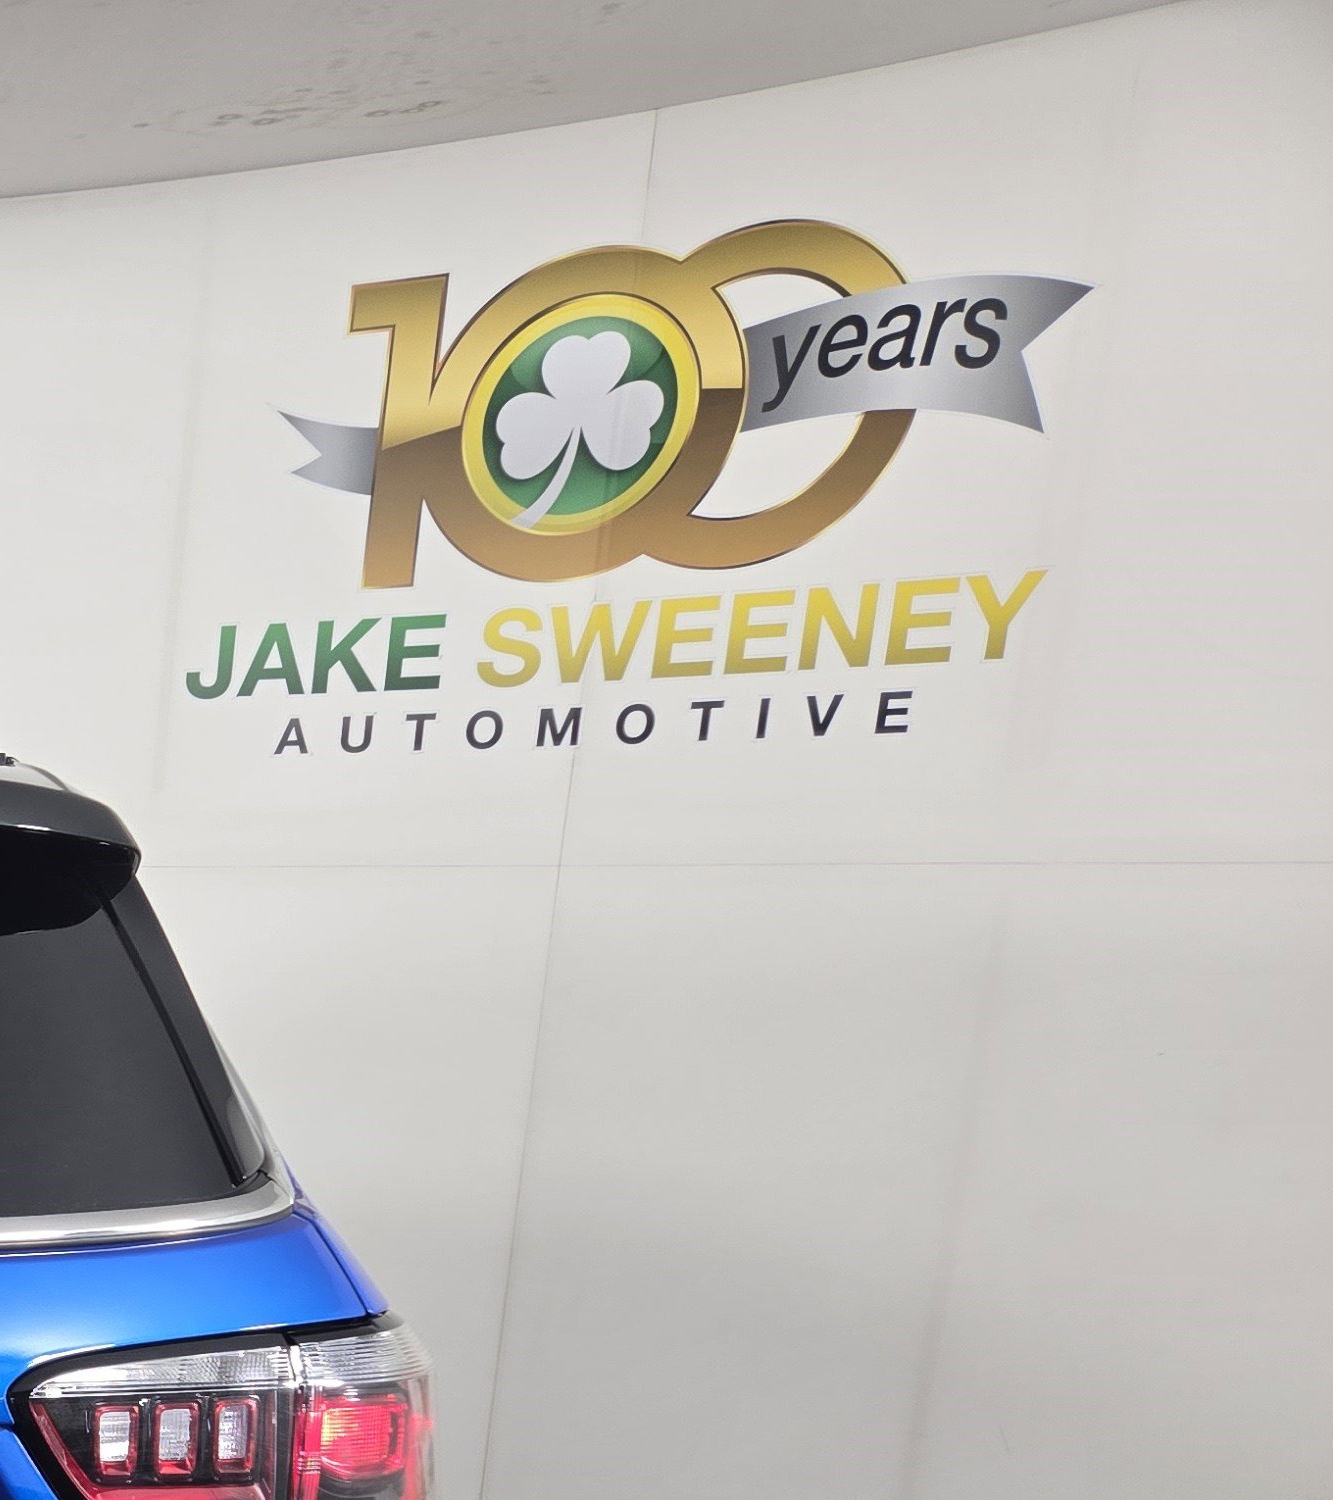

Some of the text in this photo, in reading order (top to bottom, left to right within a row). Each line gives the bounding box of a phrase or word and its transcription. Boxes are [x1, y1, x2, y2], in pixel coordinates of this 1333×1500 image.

[762, 297, 1007, 413] years
[185, 570, 1047, 700] JAKE SWEENEY
[274, 690, 913, 758] AUTOMOTIVE
